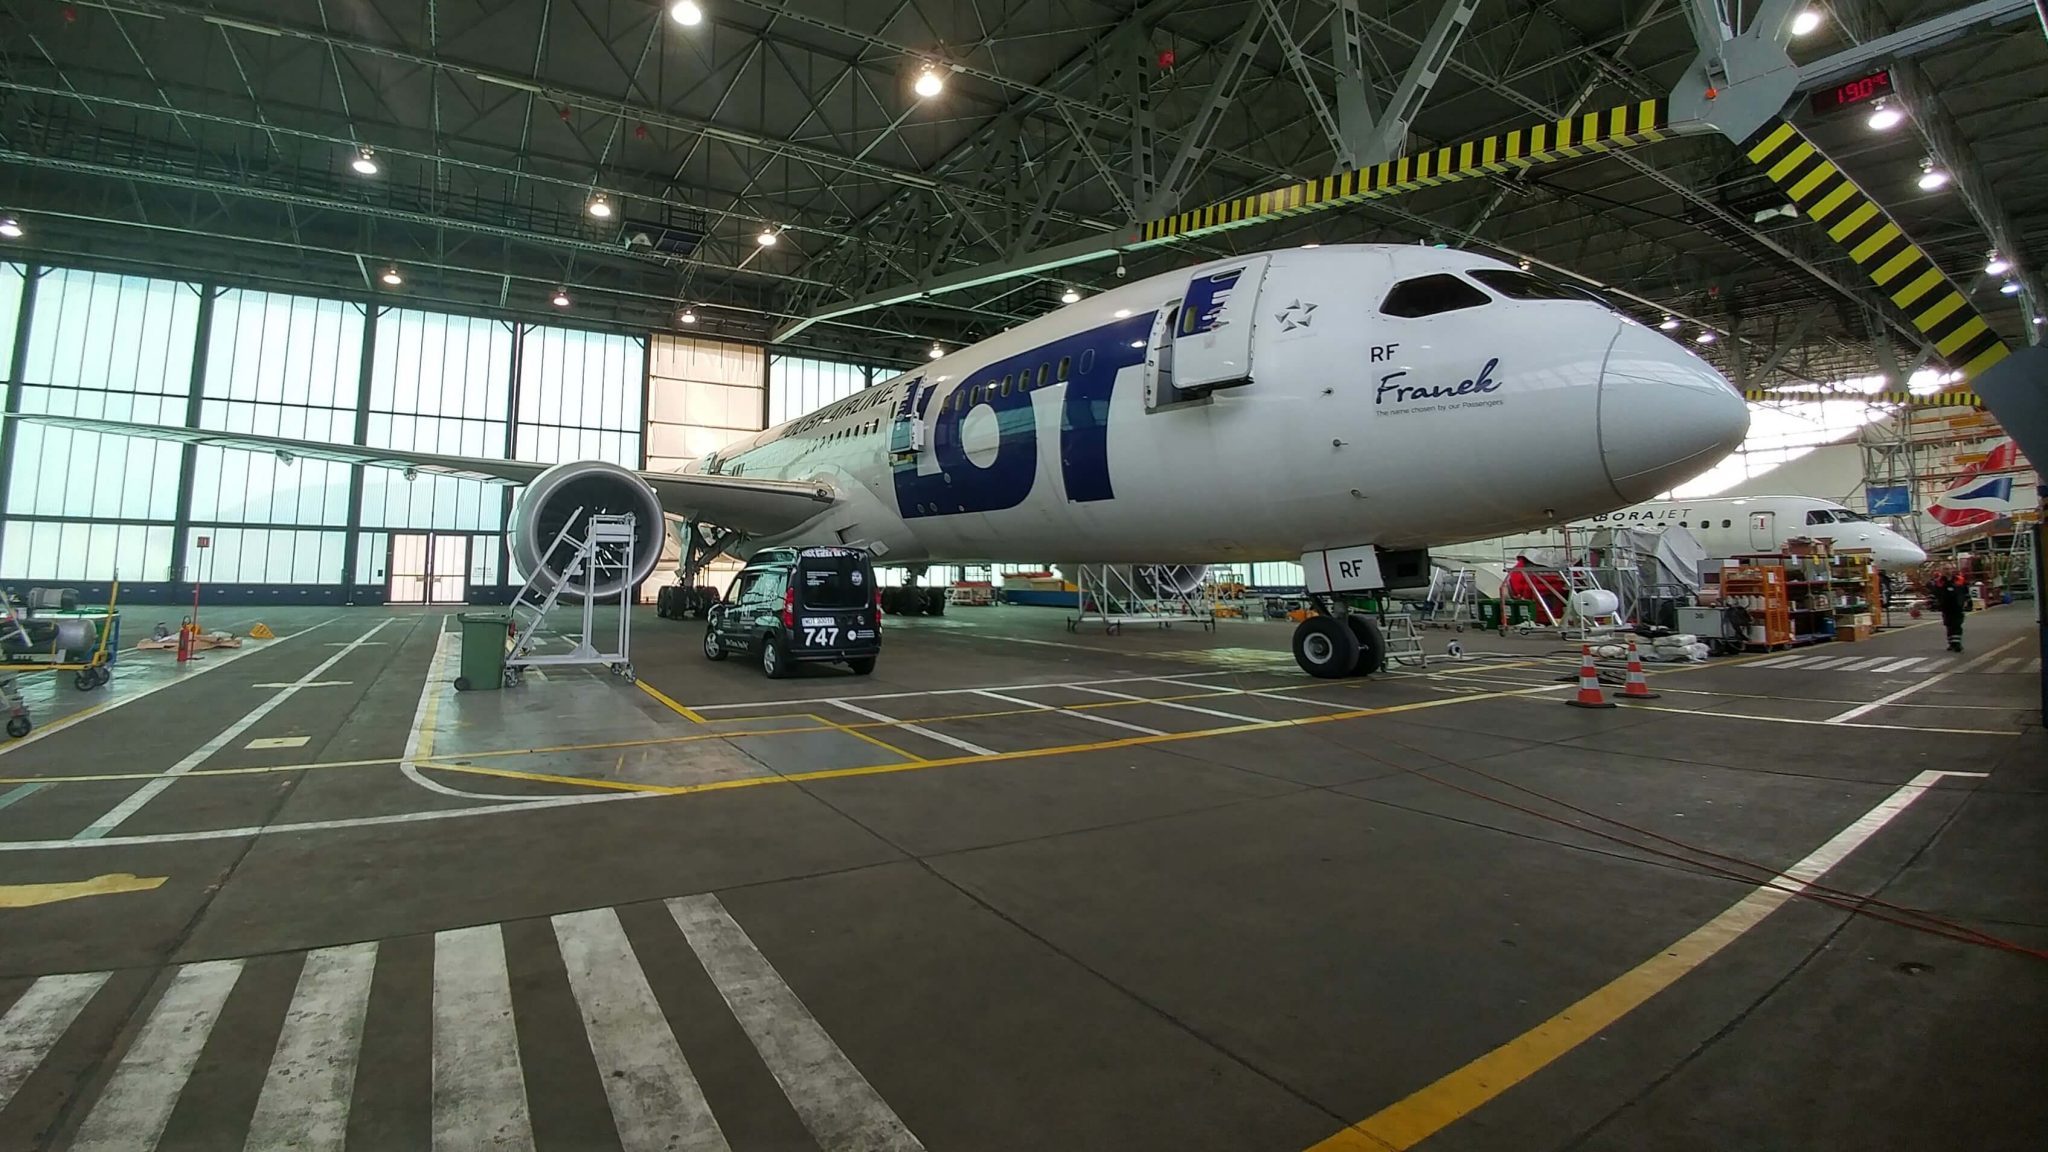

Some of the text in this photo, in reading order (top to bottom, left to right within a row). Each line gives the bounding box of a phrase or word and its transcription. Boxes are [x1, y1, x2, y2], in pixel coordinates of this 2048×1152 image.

[1370, 343, 1400, 363] RF
[1376, 357, 1503, 405] Franek
[893, 308, 1160, 519] LOT
[1390, 408, 1410, 416] name
[1411, 405, 1436, 414] chosen
[1437, 404, 1447, 412] by
[1462, 399, 1504, 408] Passengers
[1338, 559, 1363, 579] RF
[803, 628, 839, 647] 747
